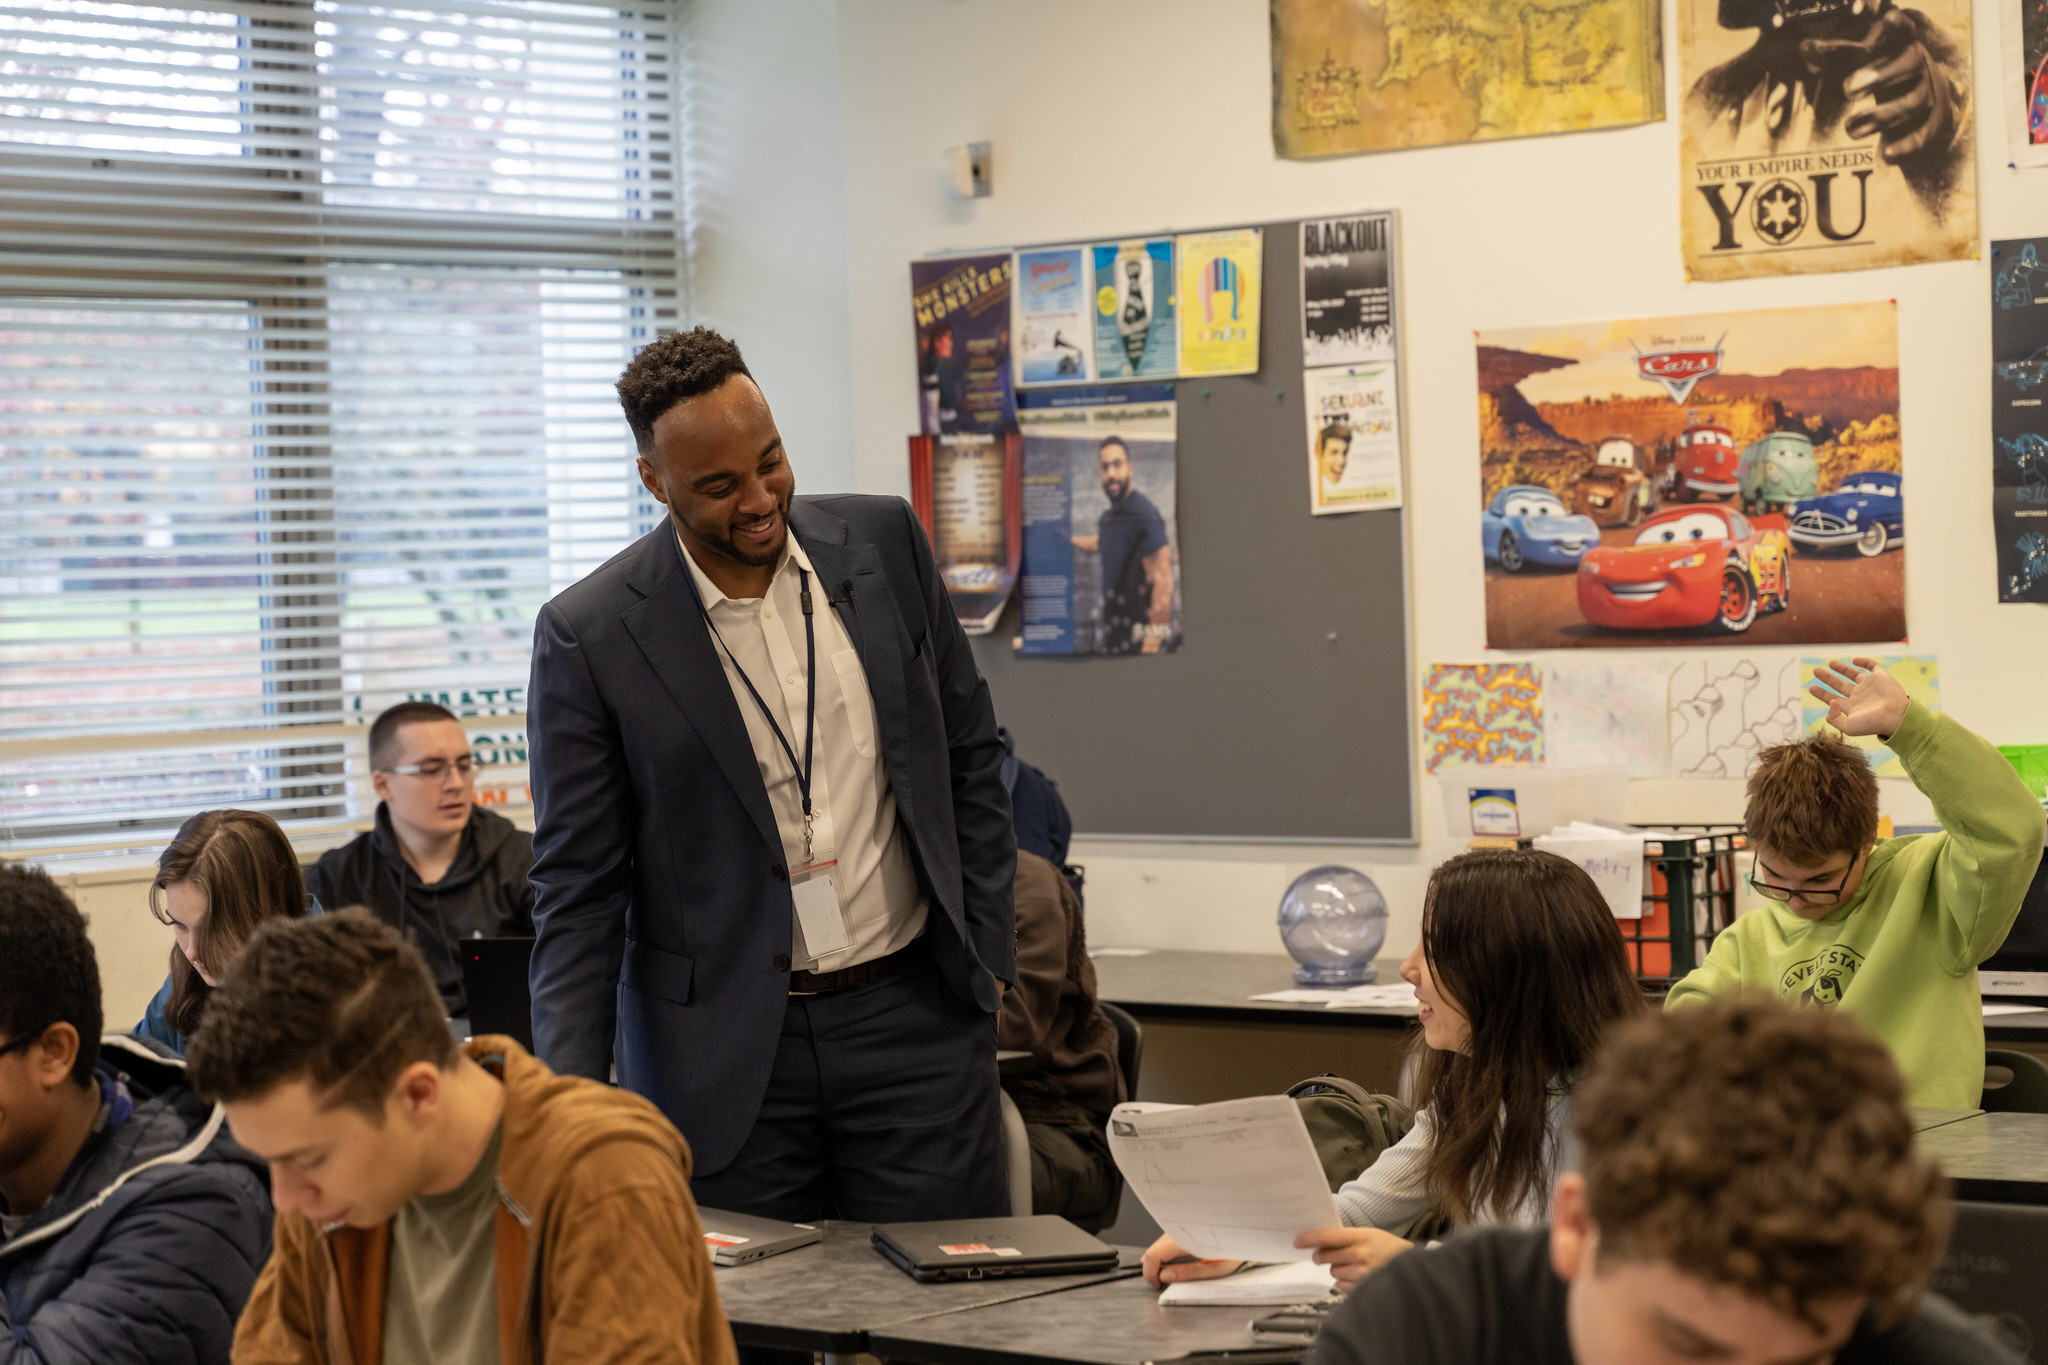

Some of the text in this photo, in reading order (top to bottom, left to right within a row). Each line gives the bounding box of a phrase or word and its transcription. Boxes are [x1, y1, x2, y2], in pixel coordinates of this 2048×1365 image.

[1697, 151, 1873, 182] YOUR EMPIRE NEEDS
[1696, 169, 1873, 251] YOU
[1305, 219, 1387, 255] BLACKOUT
[917, 261, 1012, 328] MONSTERS
[1644, 355, 1711, 375] Cars
[1828, 951, 1863, 974] STA
